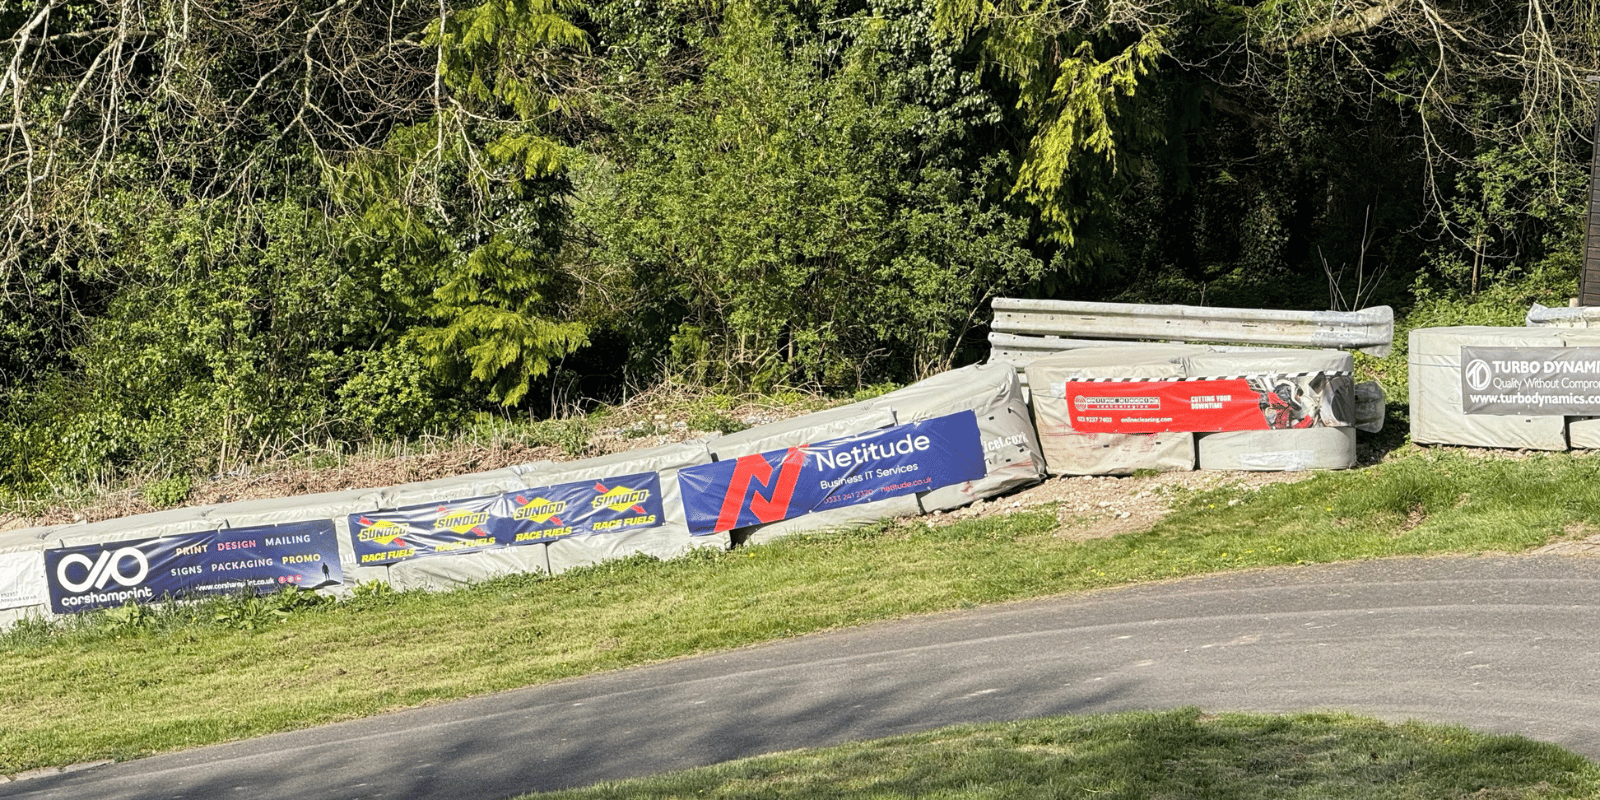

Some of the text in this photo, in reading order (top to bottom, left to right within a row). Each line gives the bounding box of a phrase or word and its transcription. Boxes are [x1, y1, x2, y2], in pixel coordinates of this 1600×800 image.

[1492, 361, 1541, 374] TURBO
[1493, 377, 1600, 391] Quality Without Compro
[1190, 394, 1232, 403] CUTTING YOUR
[1191, 402, 1223, 410] DOWNTIME
[1469, 391, 1600, 407] www.turbodynamics.co
[1120, 415, 1173, 424] onlinecleaning.com
[815, 433, 931, 472] Netitude
[820, 463, 919, 490] Business IT Services
[881, 476, 932, 492] netitude.co.uk
[594, 490, 648, 508] SUNOCO
[515, 502, 565, 519] SUNOCO
[437, 513, 488, 529] SUNOCO
[592, 514, 656, 531] RACE FUELS
[361, 524, 408, 541] SUNOCO
[515, 526, 572, 542] RACE FUELS
[175, 534, 311, 556] PRINT DESIGN MAILING
[361, 551, 387, 563] RACE
[387, 548, 415, 560] FUELS
[170, 553, 321, 577] SIGNS PACKAGING PROMO
[61, 586, 153, 607] corshamprint
